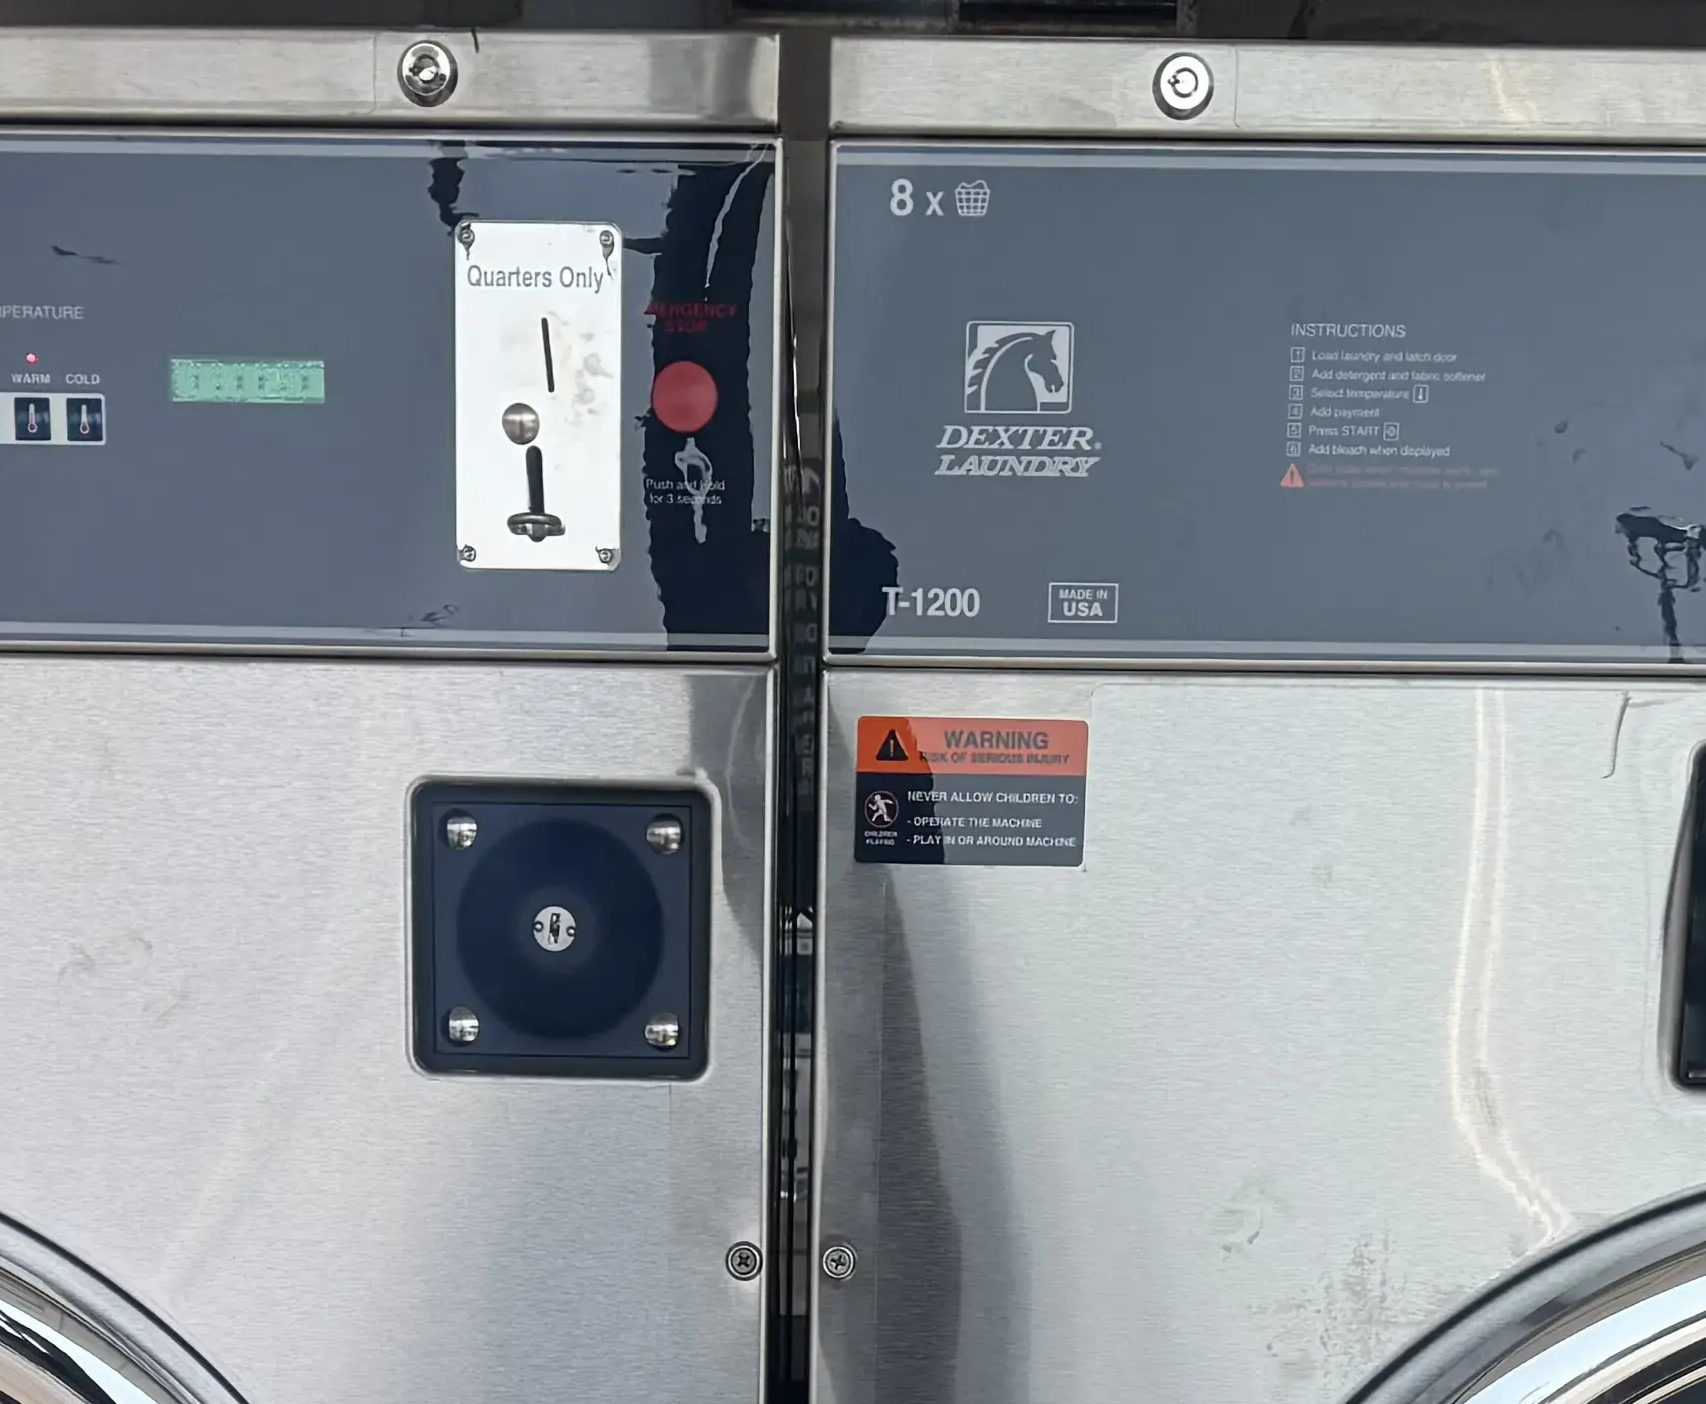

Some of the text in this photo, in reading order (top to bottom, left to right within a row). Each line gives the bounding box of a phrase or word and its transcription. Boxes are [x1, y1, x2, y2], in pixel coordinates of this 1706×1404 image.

[890, 179, 913, 216] 8
[466, 264, 604, 293] Quarters Only
[1291, 323, 1406, 338] INSTRUCTIONS
[11, 373, 51, 384] WARM
[65, 373, 100, 385] COLD
[1311, 388, 1410, 400] Select temperature
[1310, 407, 1380, 419] Add payment
[935, 425, 1094, 450] DEXTER
[1309, 426, 1380, 436] Press START
[934, 455, 1101, 477] LAUNDRY
[1059, 589, 1108, 600] MADE IN
[882, 587, 981, 617] T-1200
[1063, 602, 1102, 617] USA
[944, 730, 1048, 749] WARNING
[920, 751, 1069, 765] RISK OF SERIOUS INJURY
[908, 791, 947, 802] NEVER
[950, 791, 993, 802] ALLOW
[996, 793, 1055, 804] CHILDREN
[914, 817, 1042, 829] OPERATE THE MACHINE
[913, 836, 1076, 847] PLAY IN OR AROUND MACHINE
